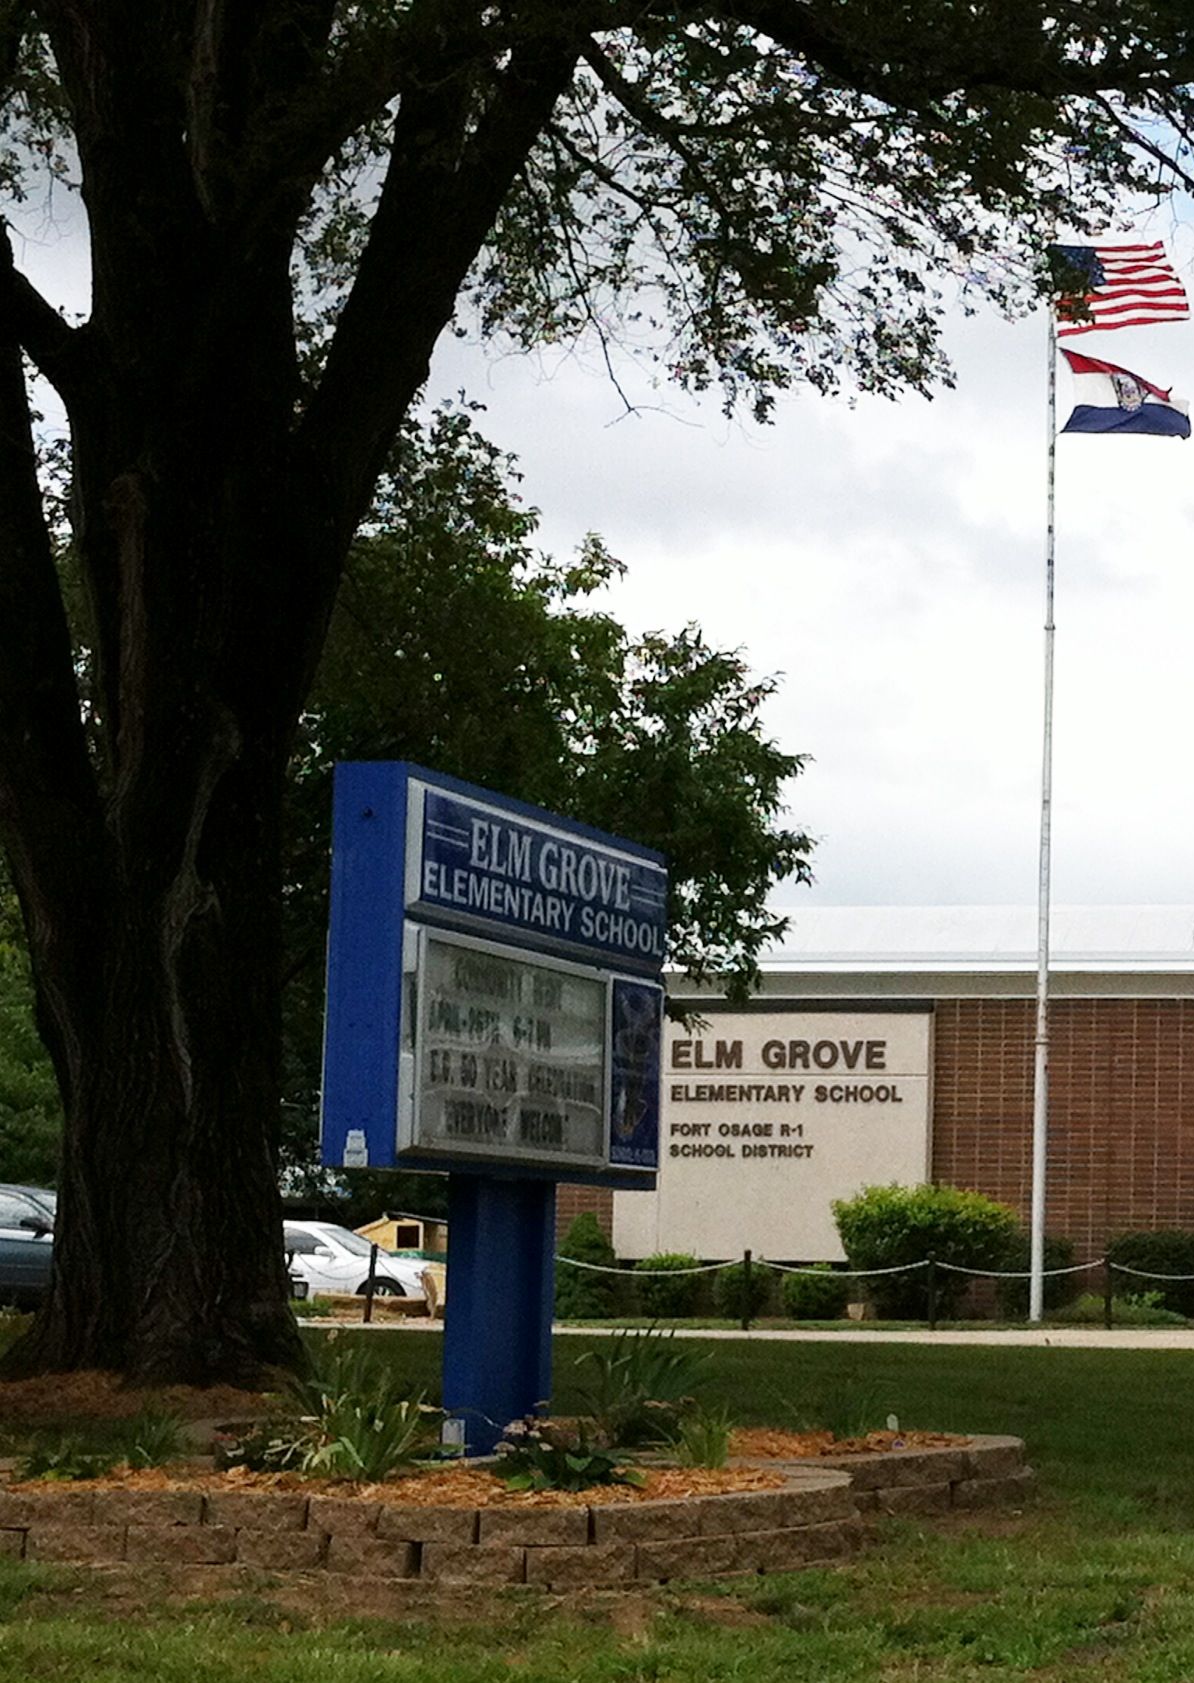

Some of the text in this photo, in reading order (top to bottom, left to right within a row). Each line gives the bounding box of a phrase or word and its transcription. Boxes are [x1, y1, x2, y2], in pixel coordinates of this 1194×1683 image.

[469, 817, 633, 912] ELM GROVE
[423, 860, 666, 956] ELEMENTARY SCHOOL
[670, 1039, 887, 1070] ELM GROVE
[670, 1085, 903, 1103] ELEMENTARY SCHOOL
[670, 1123, 803, 1137] FORT OSAGE R-1
[670, 1144, 735, 1158] SCHOOL
[742, 1144, 813, 1158] DISTRICT
